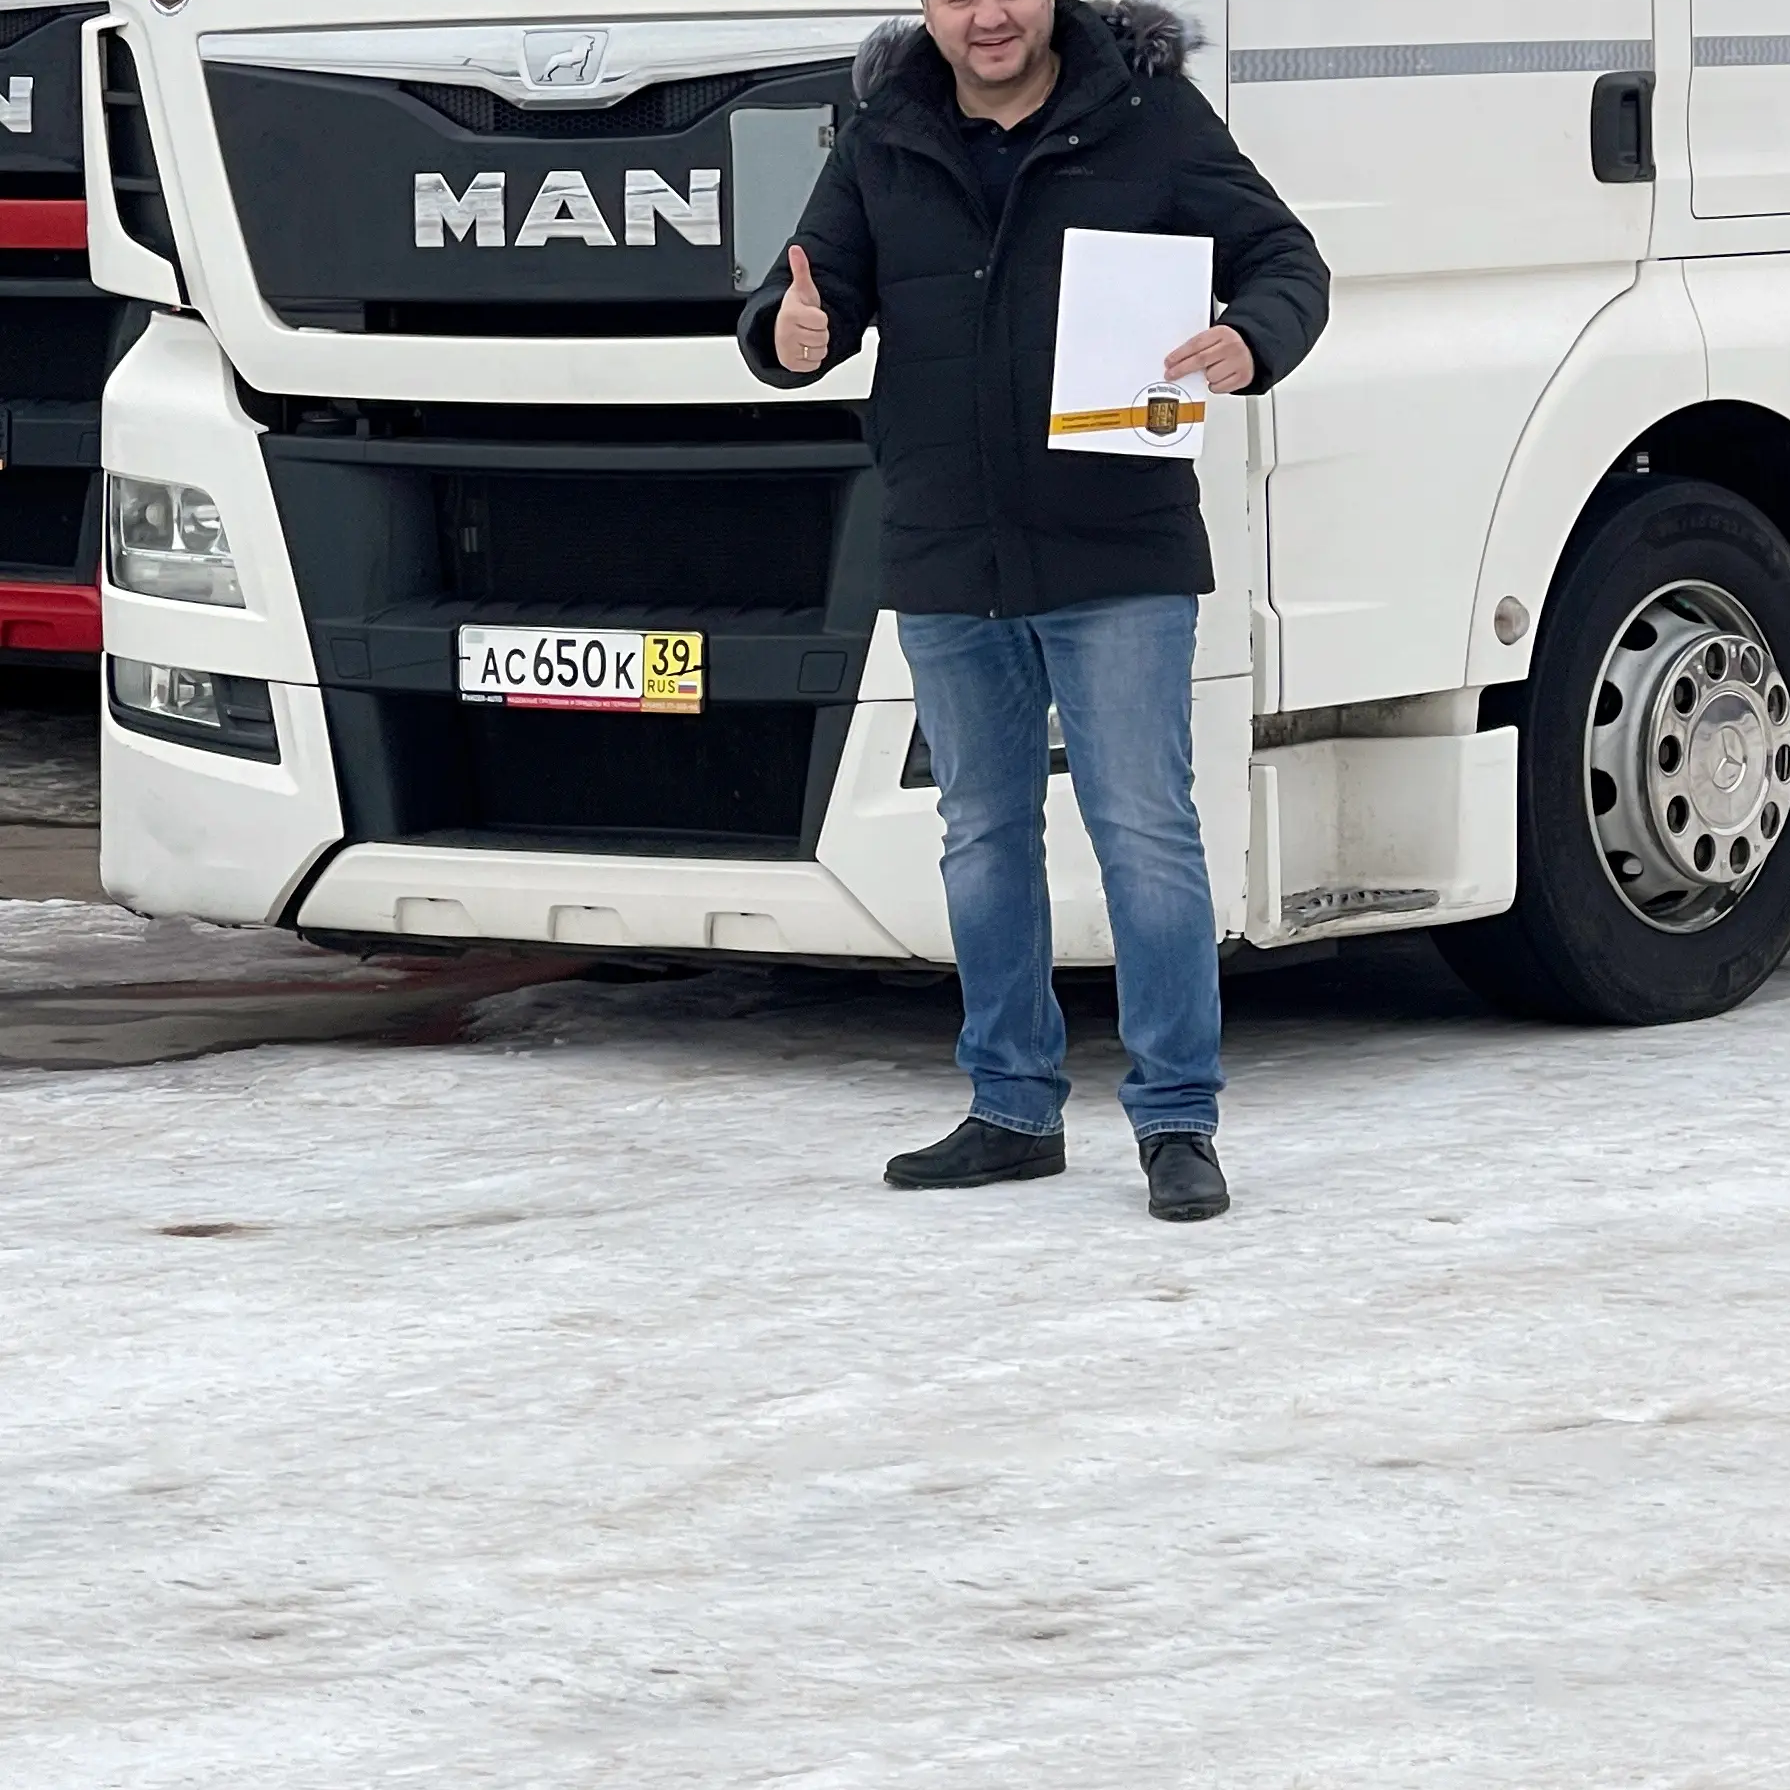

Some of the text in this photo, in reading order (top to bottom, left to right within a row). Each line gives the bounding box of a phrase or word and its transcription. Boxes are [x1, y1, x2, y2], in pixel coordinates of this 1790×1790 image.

[415, 169, 721, 247] MAN
[652, 638, 691, 677] 39
[647, 679, 676, 693] RUS
